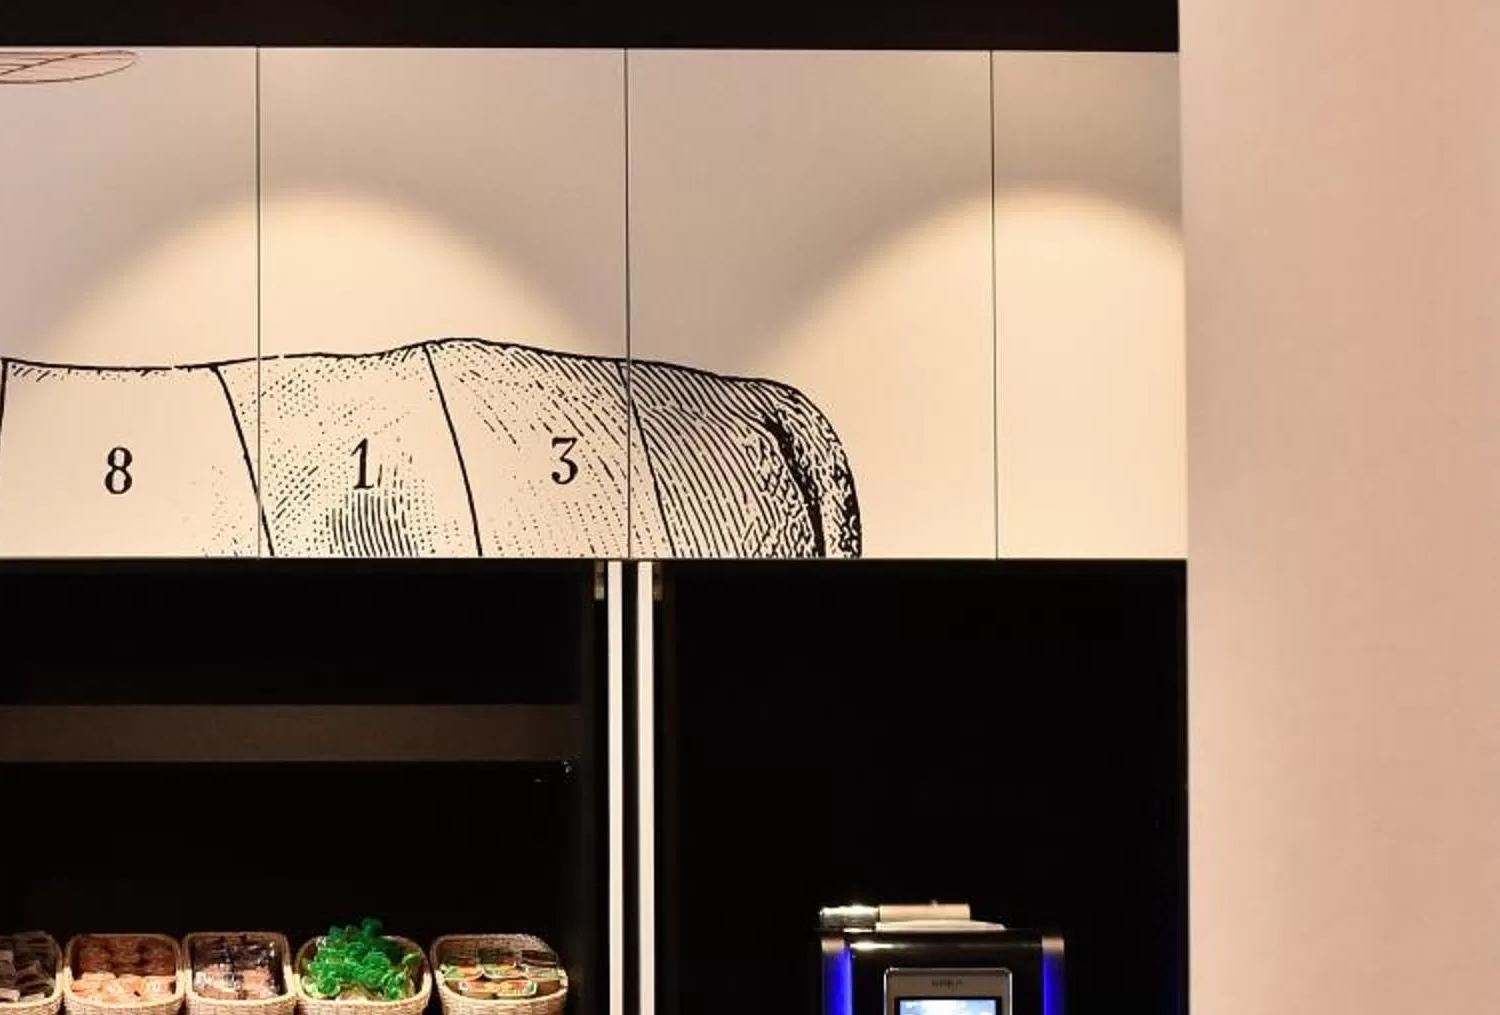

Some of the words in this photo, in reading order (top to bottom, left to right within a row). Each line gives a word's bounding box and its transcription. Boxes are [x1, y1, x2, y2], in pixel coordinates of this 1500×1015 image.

[104, 446, 133, 495] 8
[350, 438, 375, 490] 1
[551, 436, 579, 485] 3
